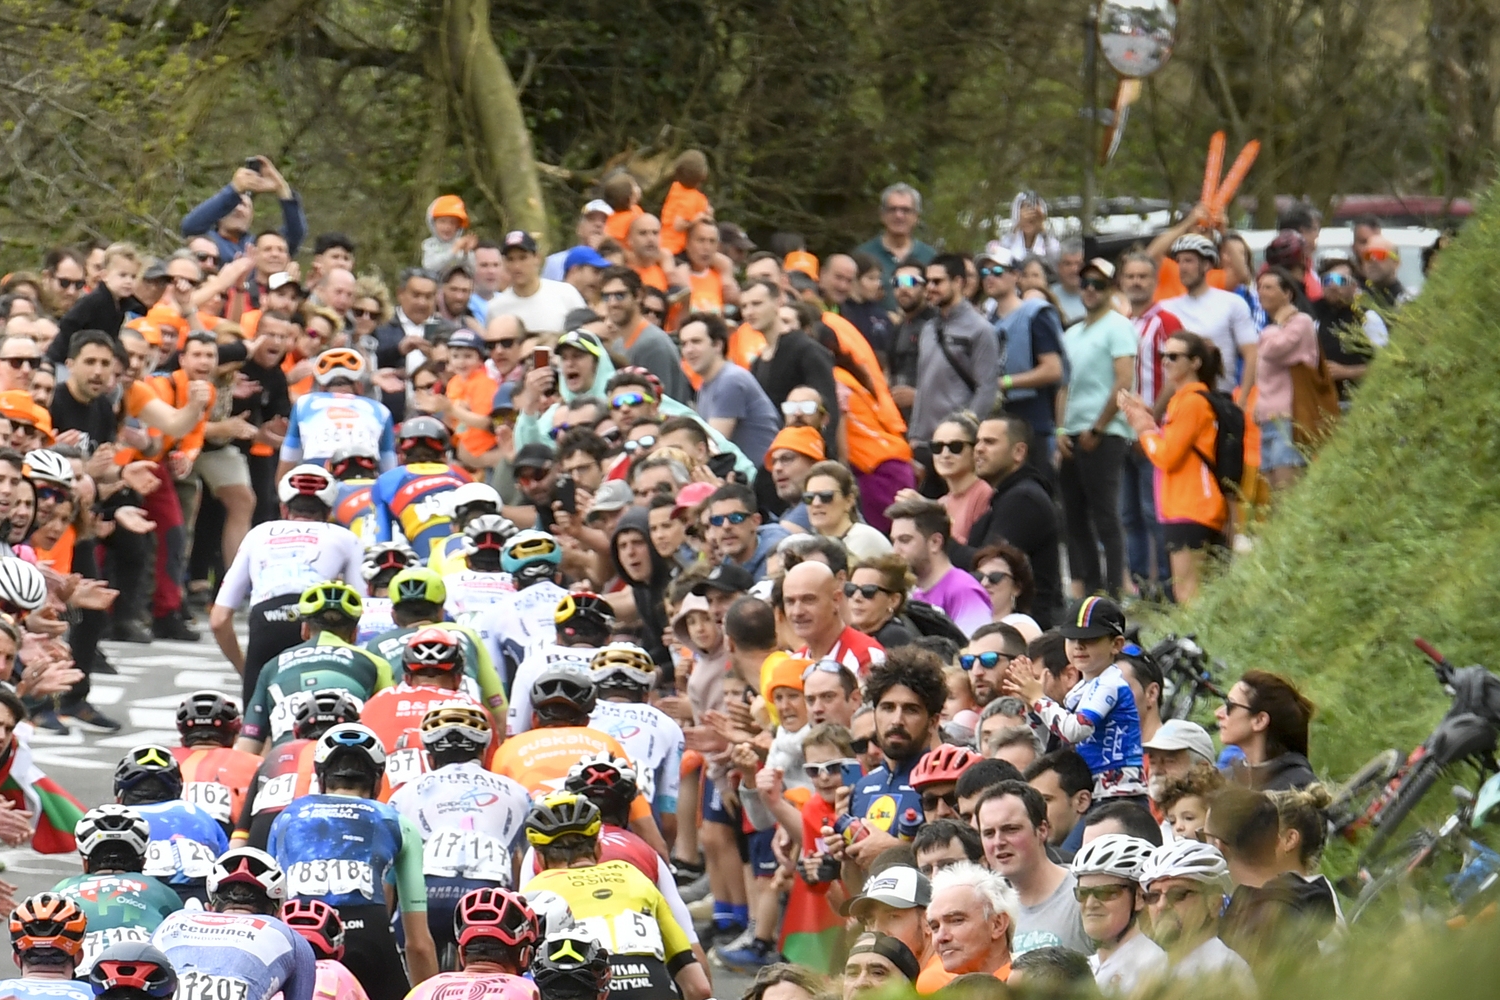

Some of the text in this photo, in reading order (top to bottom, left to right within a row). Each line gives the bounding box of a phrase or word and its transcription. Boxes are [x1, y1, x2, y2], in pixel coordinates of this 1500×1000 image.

[389, 750, 415, 773] 57
[189, 784, 230, 806] 162
[633, 915, 646, 937] 5
